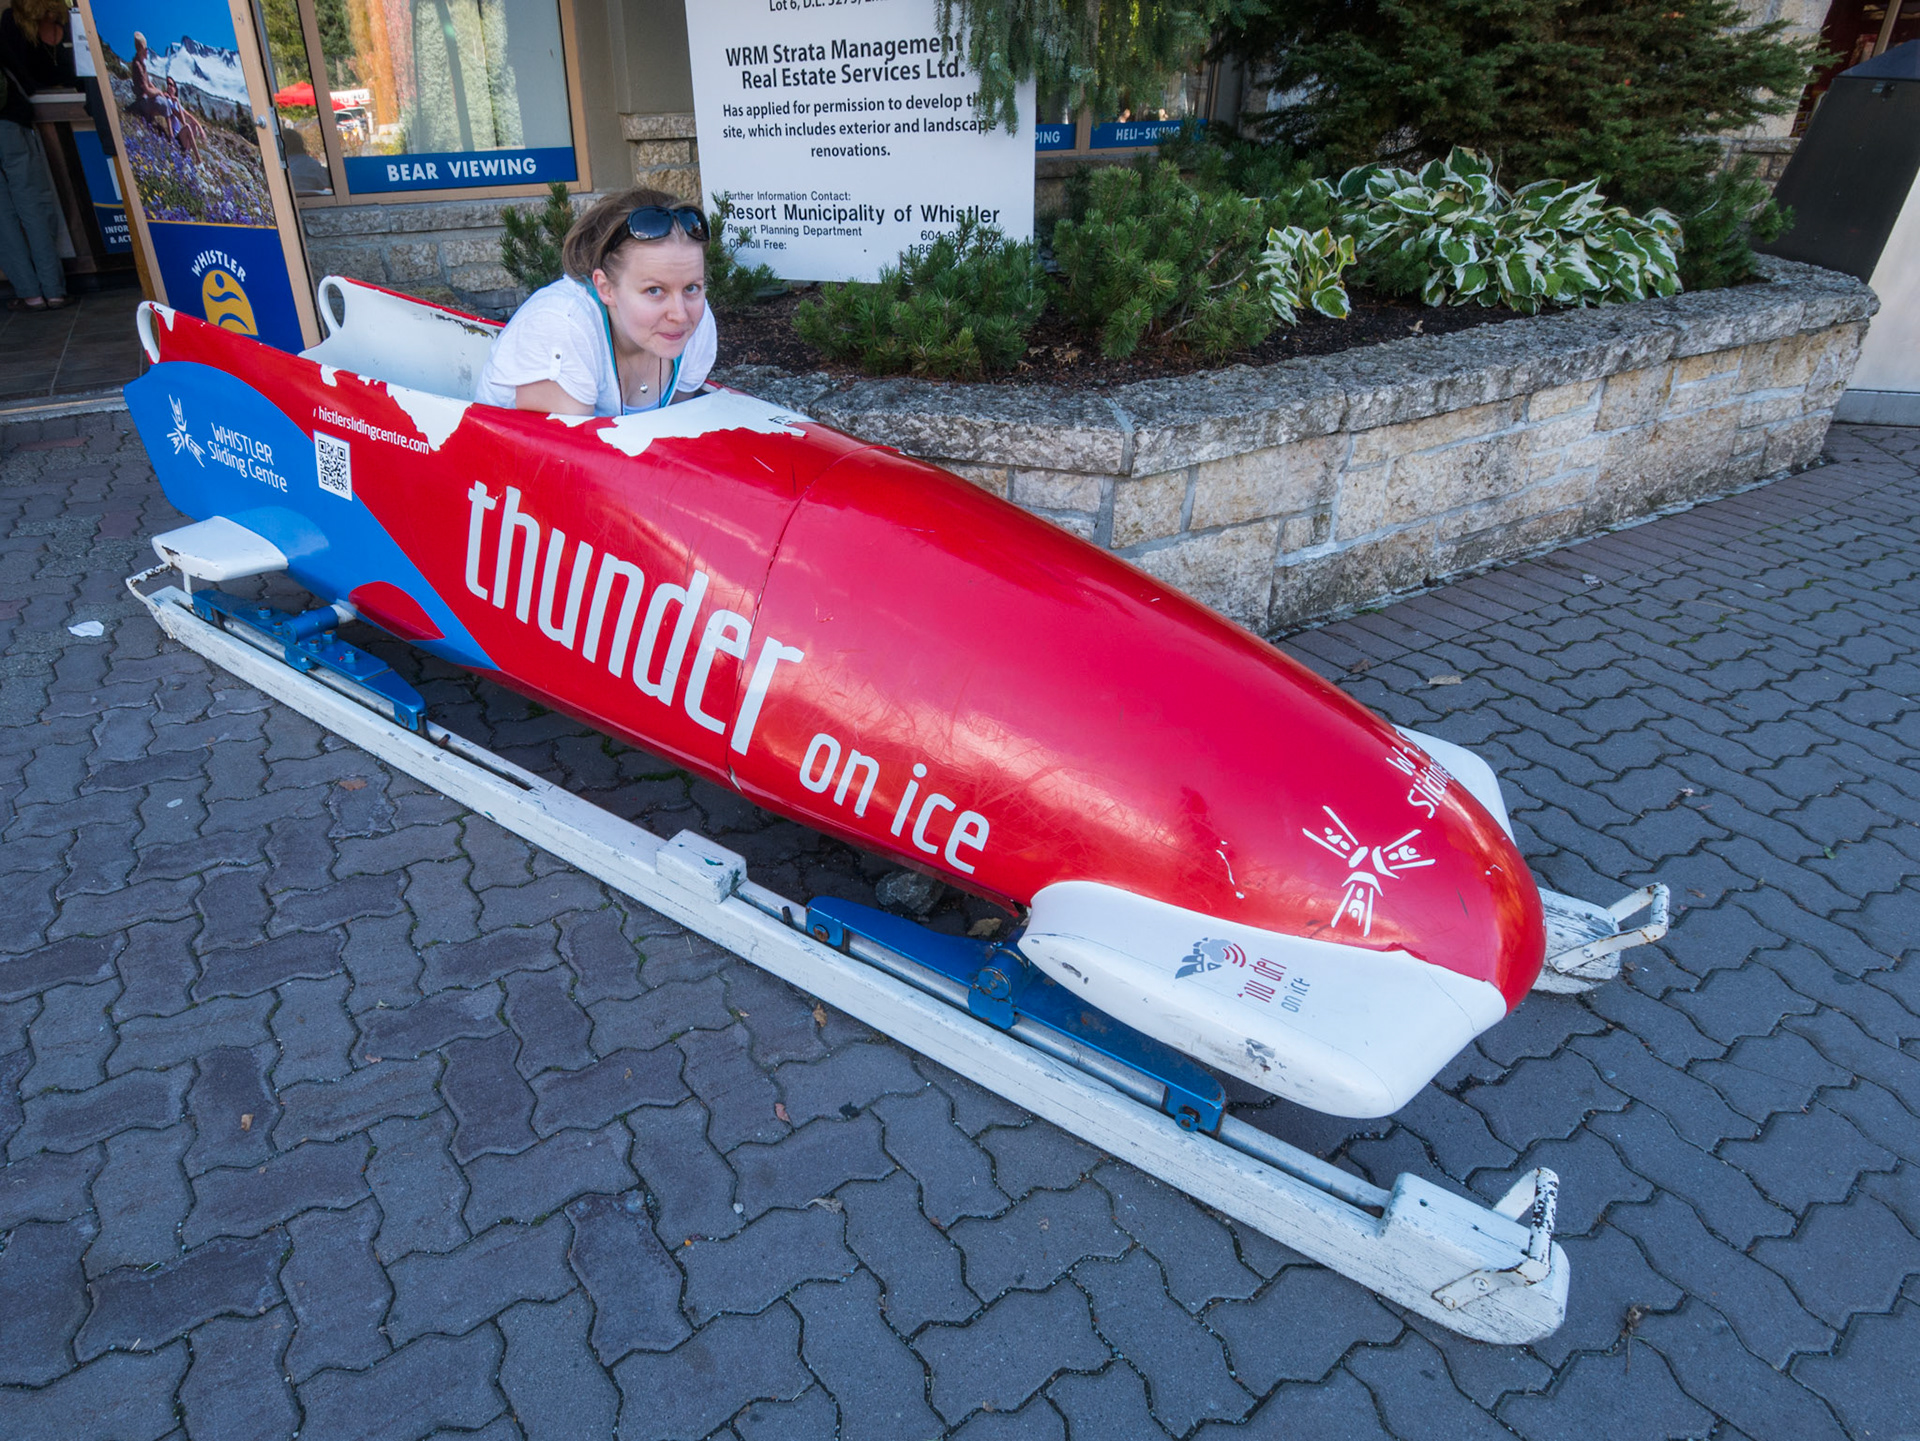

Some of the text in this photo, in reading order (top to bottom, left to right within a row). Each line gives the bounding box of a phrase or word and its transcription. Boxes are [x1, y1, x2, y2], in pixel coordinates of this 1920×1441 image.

[769, 0, 788, 12] Lot
[725, 45, 769, 67] WRM
[773, 43, 826, 64] Strata
[742, 56, 965, 89] Real Estate Services Ltd.
[723, 104, 744, 117] Has
[746, 101, 790, 119] applied
[793, 100, 811, 114] for
[813, 97, 885, 117] permission
[888, 98, 902, 111] to
[905, 93, 963, 112] develop
[723, 125, 746, 139] site,
[747, 123, 782, 138] which
[785, 121, 836, 137] includes
[839, 119, 891, 135] exterior
[894, 118, 920, 133] and
[811, 142, 891, 158] renovations.
[386, 157, 538, 182] BEAR VIEWING
[724, 190, 852, 201] Further Information Contact:
[726, 203, 1000, 225] Resort Municipality of Whistler
[727, 223, 758, 235] Resort
[760, 224, 799, 237] Planning
[803, 225, 862, 238] Department
[763, 239, 787, 250] Free:
[191, 249, 248, 283] WHISTLER
[207, 440, 288, 493] Sliding Centre
[464, 480, 804, 756] thunder
[799, 732, 990, 875] on ice
[1281, 994, 1304, 1013] on
